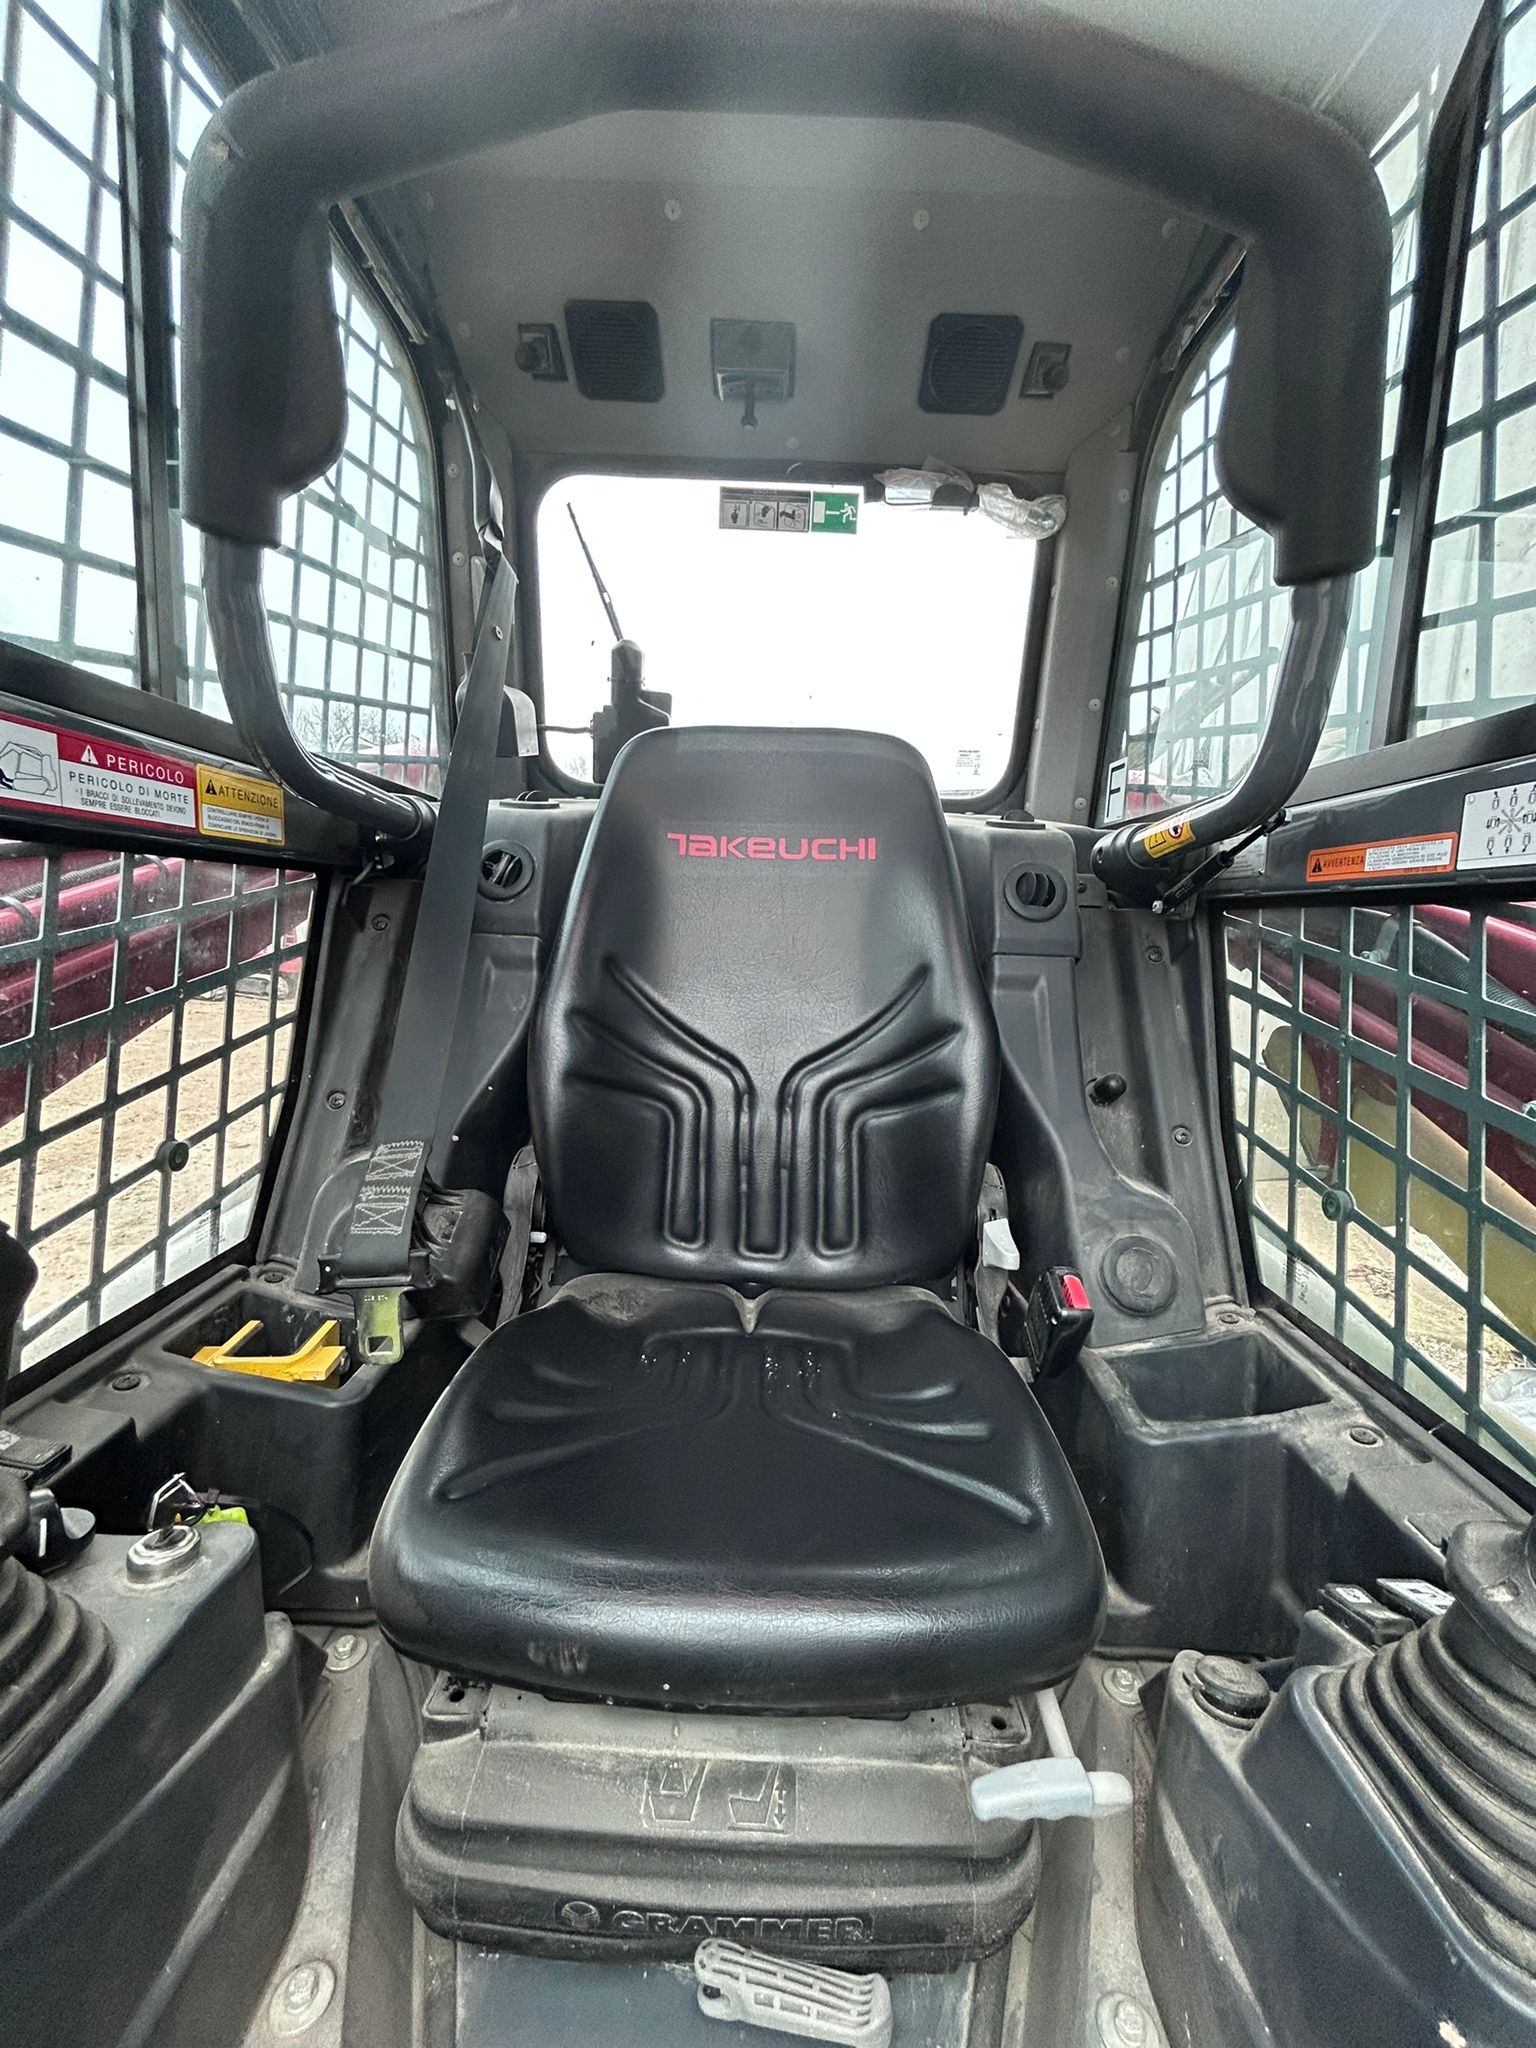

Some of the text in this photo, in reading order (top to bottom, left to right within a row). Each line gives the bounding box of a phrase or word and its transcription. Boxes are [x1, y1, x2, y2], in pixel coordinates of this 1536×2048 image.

[106, 754, 184, 784] PERICOLO
[69, 771, 189, 804] PERICOLO DI MORTE
[218, 785, 279, 808] ATTENZIONE
[80, 797, 106, 809] SEMPRE
[110, 803, 132, 814] ESSERE
[86, 789, 109, 801] BRACCI
[112, 793, 119, 802] DI
[121, 795, 164, 811] SOLLEVAMENTO
[166, 805, 187, 815] DEVONO
[667, 832, 876, 861] TAKEUCHI
[1322, 855, 1364, 868] AVVERTENZA
[612, 1909, 865, 1940] GRAMMER
